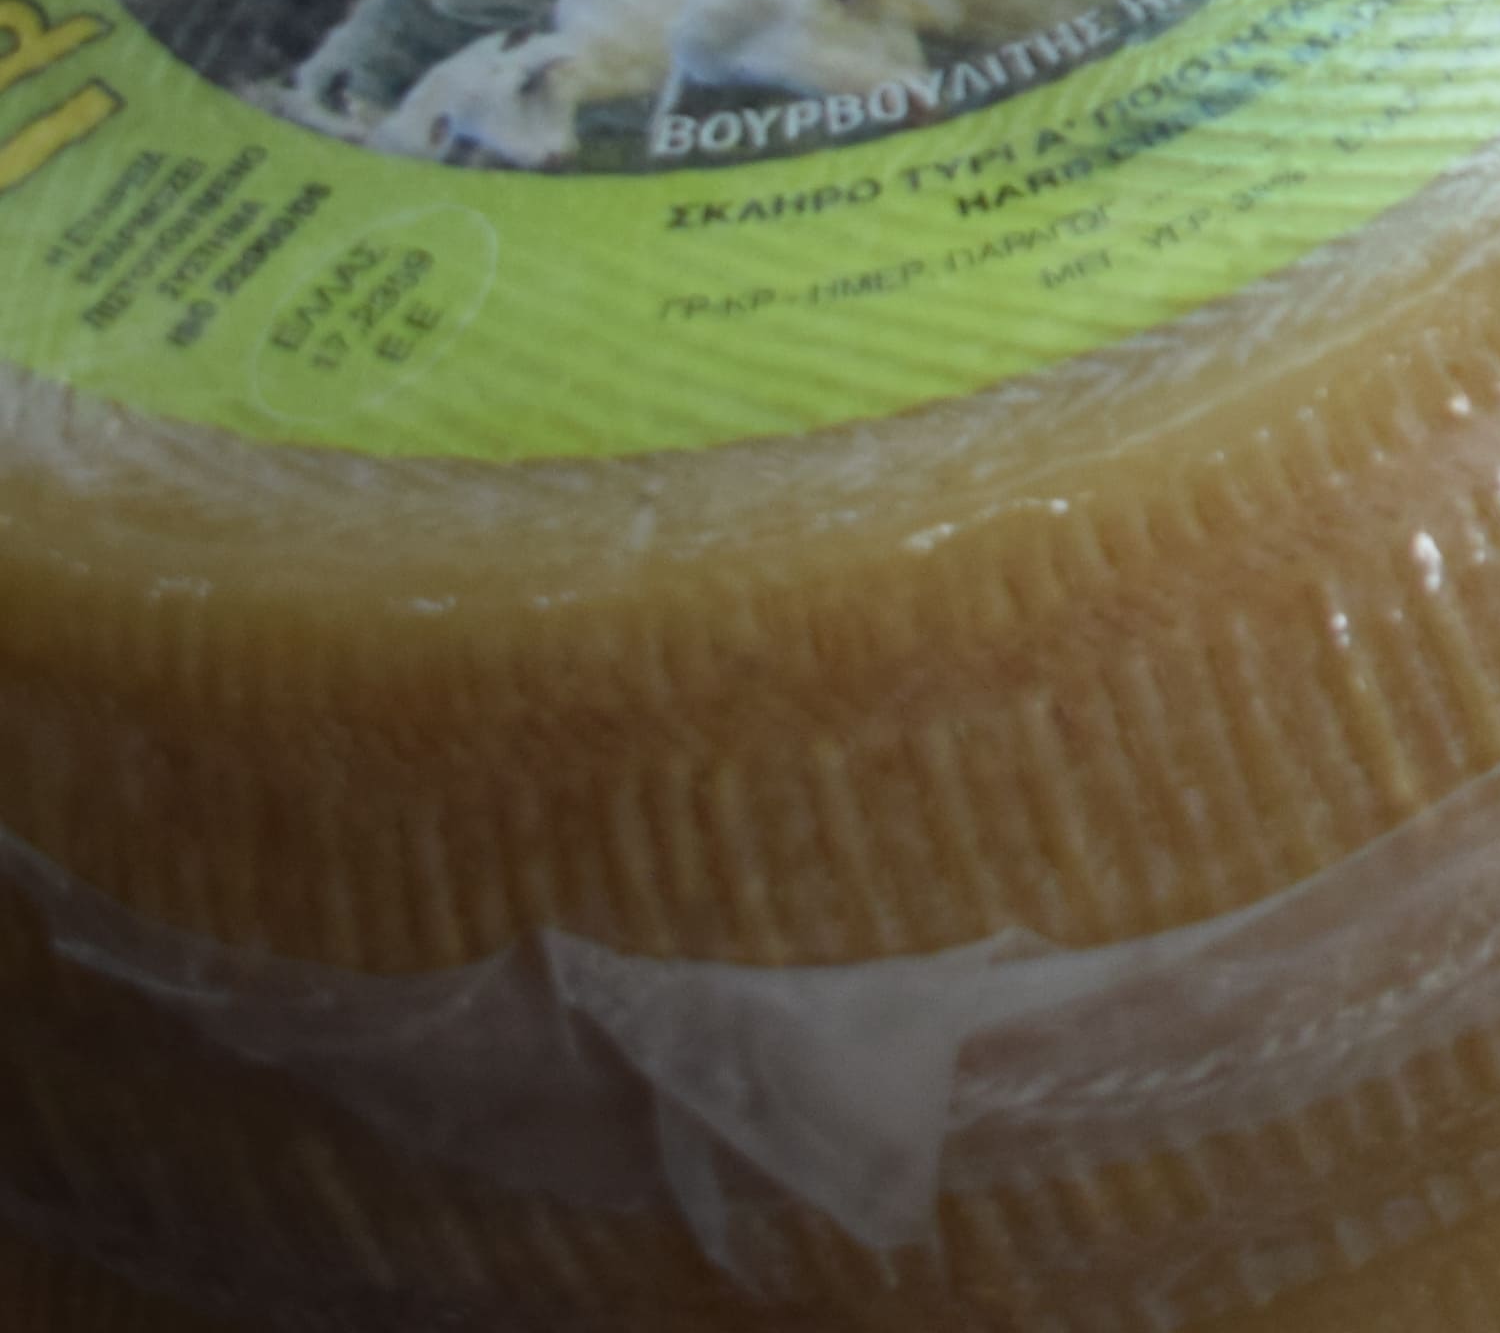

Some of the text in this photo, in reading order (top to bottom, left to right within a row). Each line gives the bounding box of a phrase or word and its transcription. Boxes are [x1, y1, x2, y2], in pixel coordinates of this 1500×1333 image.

[651, 9, 1117, 157] ΒΟΥΡΒΟΥΛΙΤΗΣ
[667, 180, 882, 232] ΣΚΛΗΡΟ
[901, 144, 1017, 194] ΤΥΡΙ
